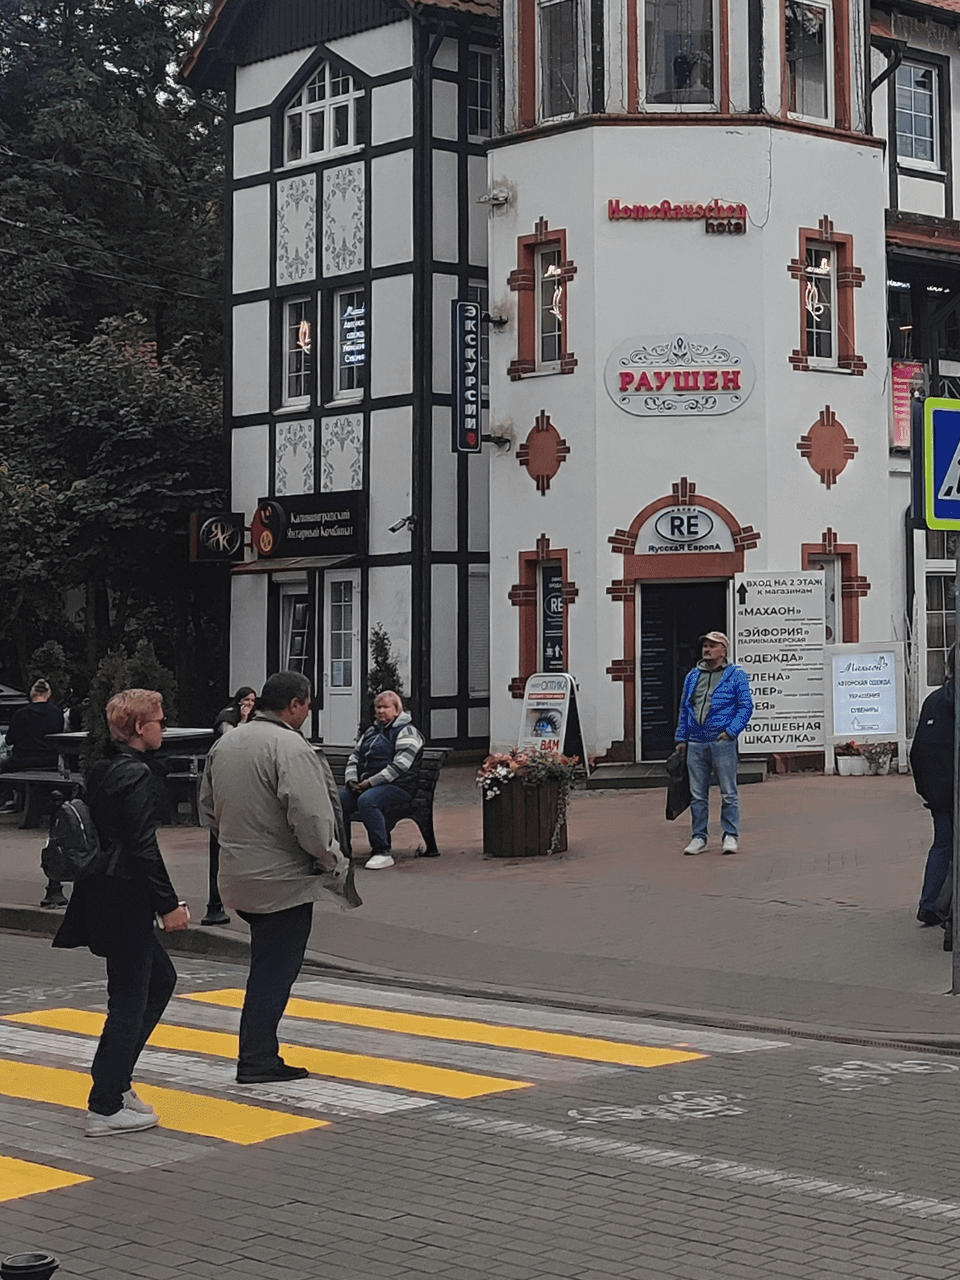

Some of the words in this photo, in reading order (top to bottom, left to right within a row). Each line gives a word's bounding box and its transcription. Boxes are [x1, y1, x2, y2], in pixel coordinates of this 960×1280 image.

[608, 199, 748, 221] HomeRauschen
[705, 218, 747, 235] hotel
[464, 306, 477, 430] ЭКСКУРСИИ
[619, 370, 742, 392] РАУШЕН
[670, 515, 699, 536] RE
[796, 578, 823, 586] ЭТАЖ
[550, 598, 563, 612] RE
[738, 606, 801, 616] «МАХАОН»
[738, 627, 809, 638] «ЭЙФОРИЯ»
[738, 653, 803, 664] «ОДЕЖДА»
[839, 662, 883, 673] Махаон
[540, 681, 567, 690] ОПТИКА
[541, 739, 560, 750] ВАМ
[744, 734, 816, 744] ШКАТУЛКА»
